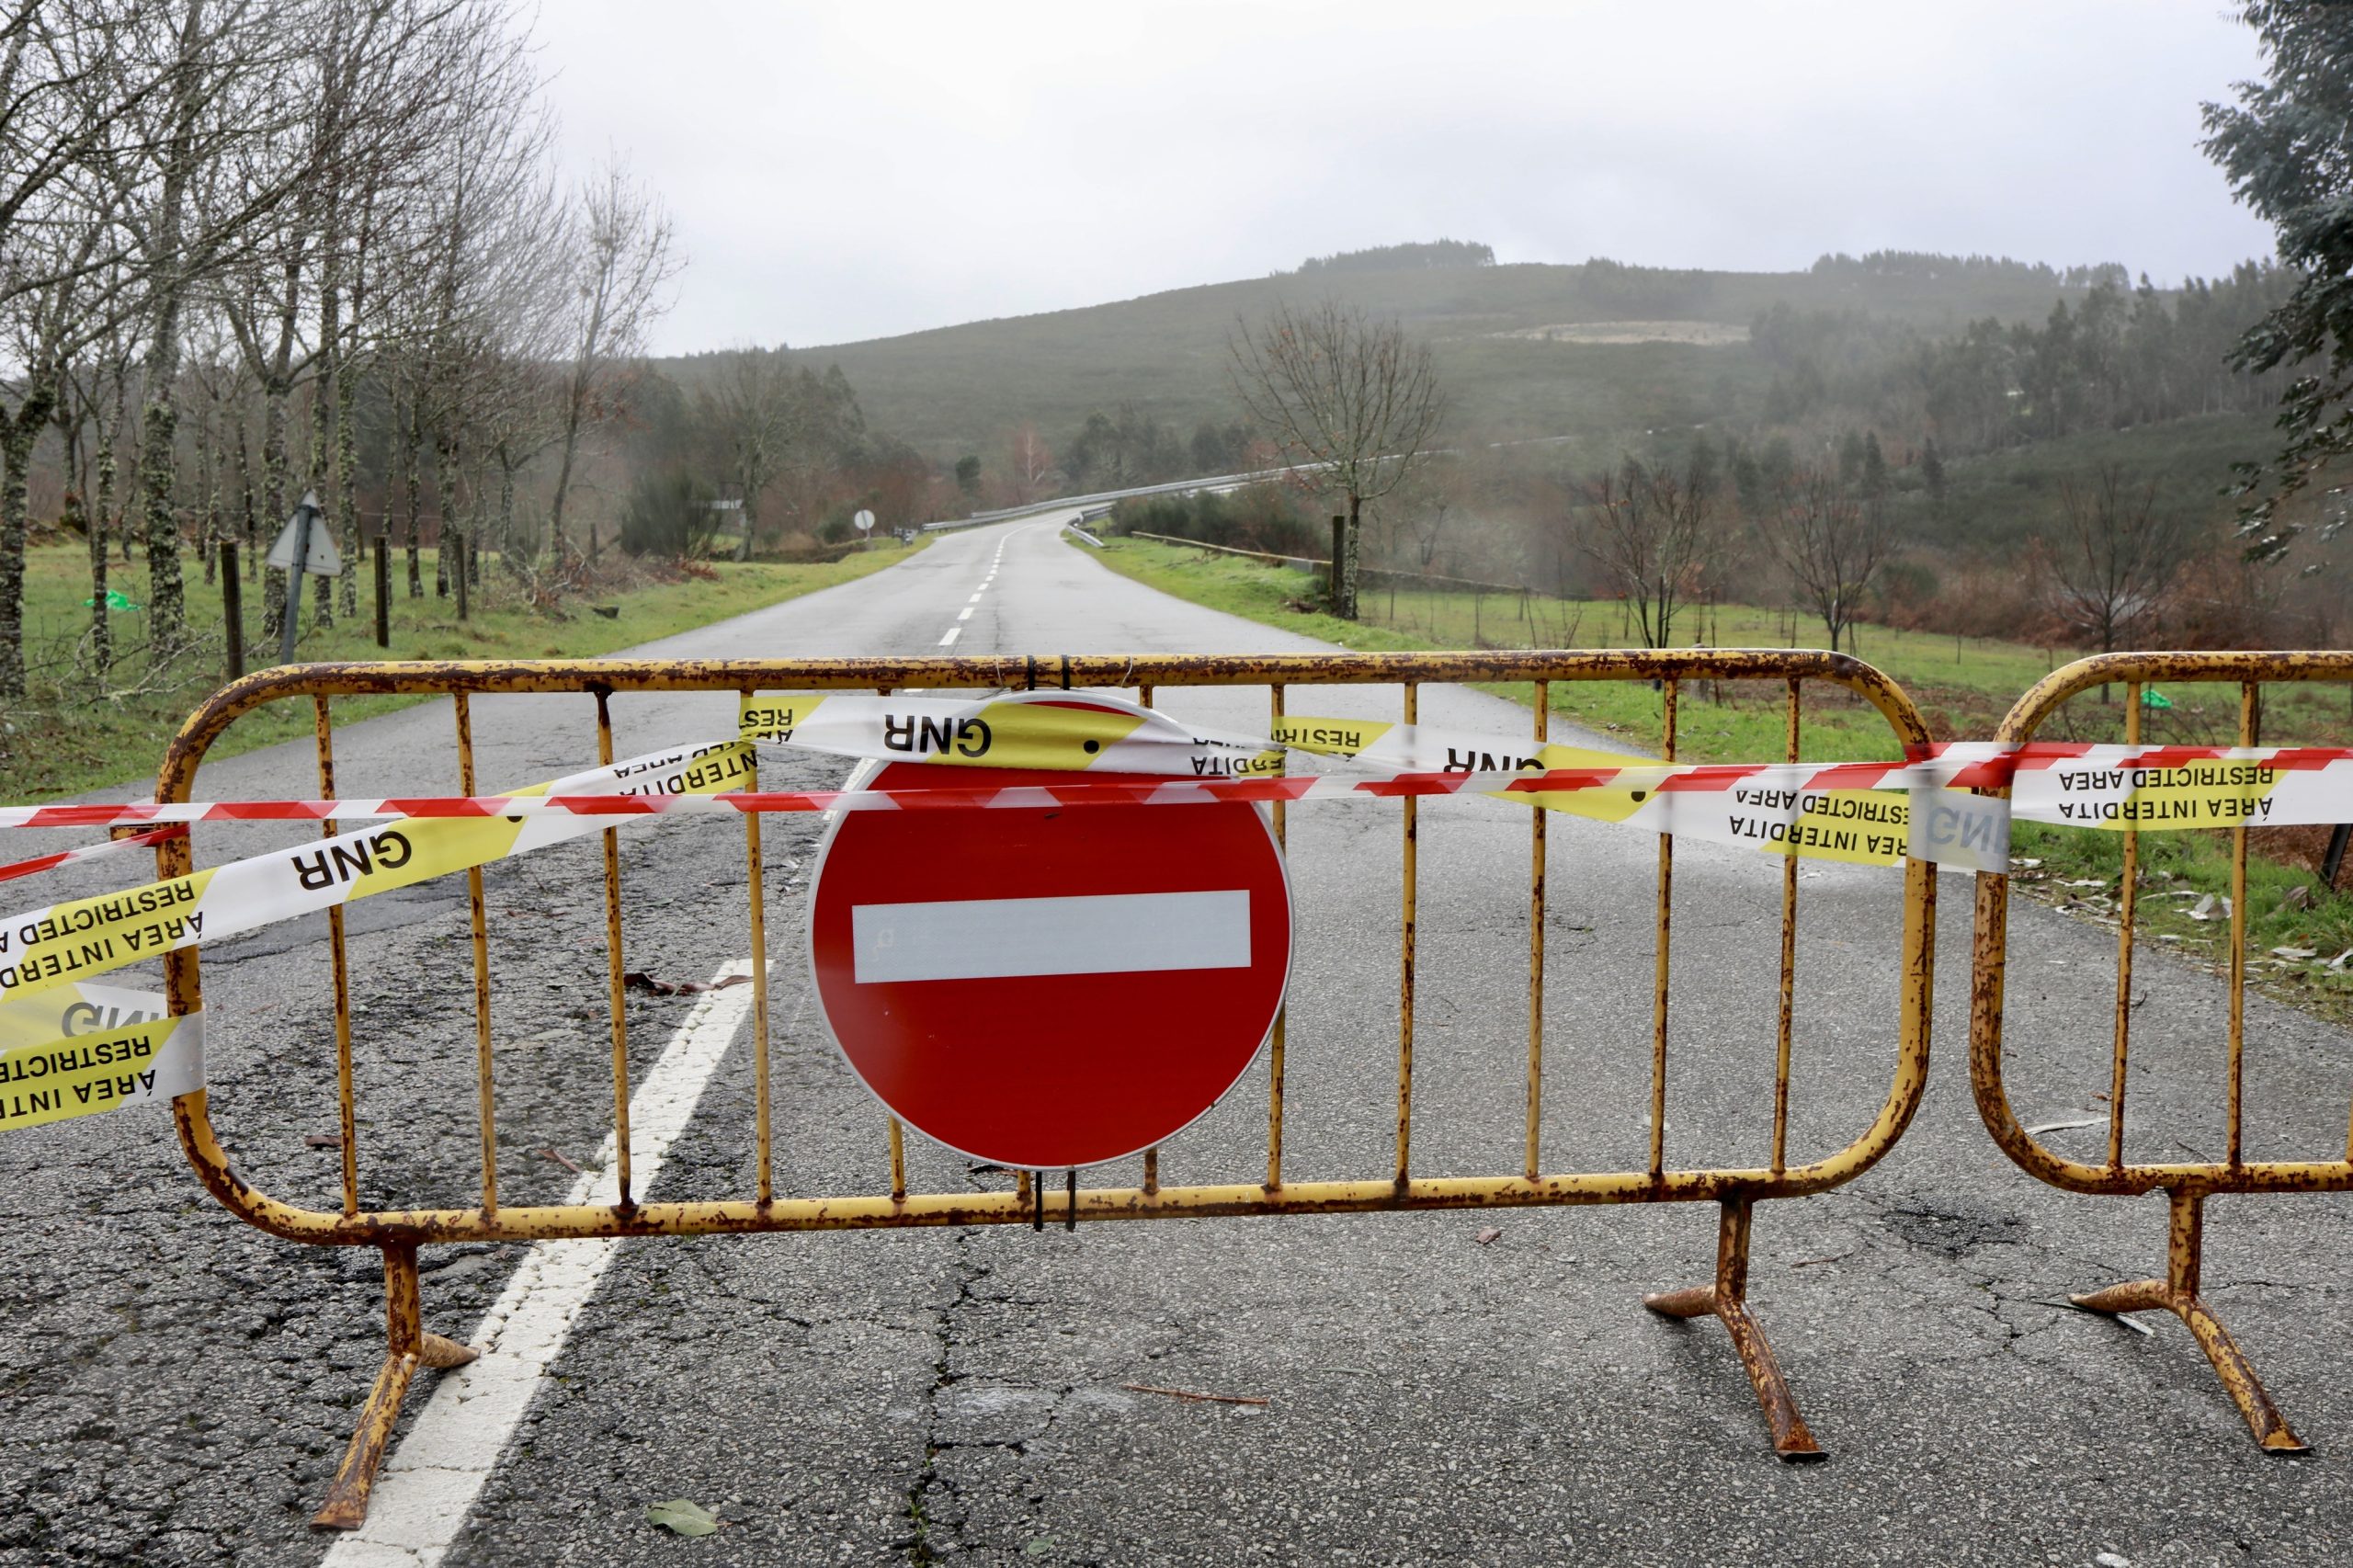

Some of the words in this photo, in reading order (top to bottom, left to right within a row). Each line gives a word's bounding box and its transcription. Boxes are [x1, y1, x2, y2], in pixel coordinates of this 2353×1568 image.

[884, 714, 992, 758] GNR
[2059, 771, 2124, 790] AREA
[2132, 767, 2274, 789] RESTRICTED
[1802, 794, 1909, 825] ESTRICTED
[2059, 800, 2197, 820] INTERDITA
[2208, 797, 2274, 821] ÁREA
[1729, 816, 1858, 851] INTERDITA
[1867, 834, 1908, 857] REA
[290, 831, 413, 891] GNR
[19, 880, 196, 946] RESTRICTED
[124, 911, 204, 952] ÁREA
[73, 1069, 156, 1104] ÁREA
